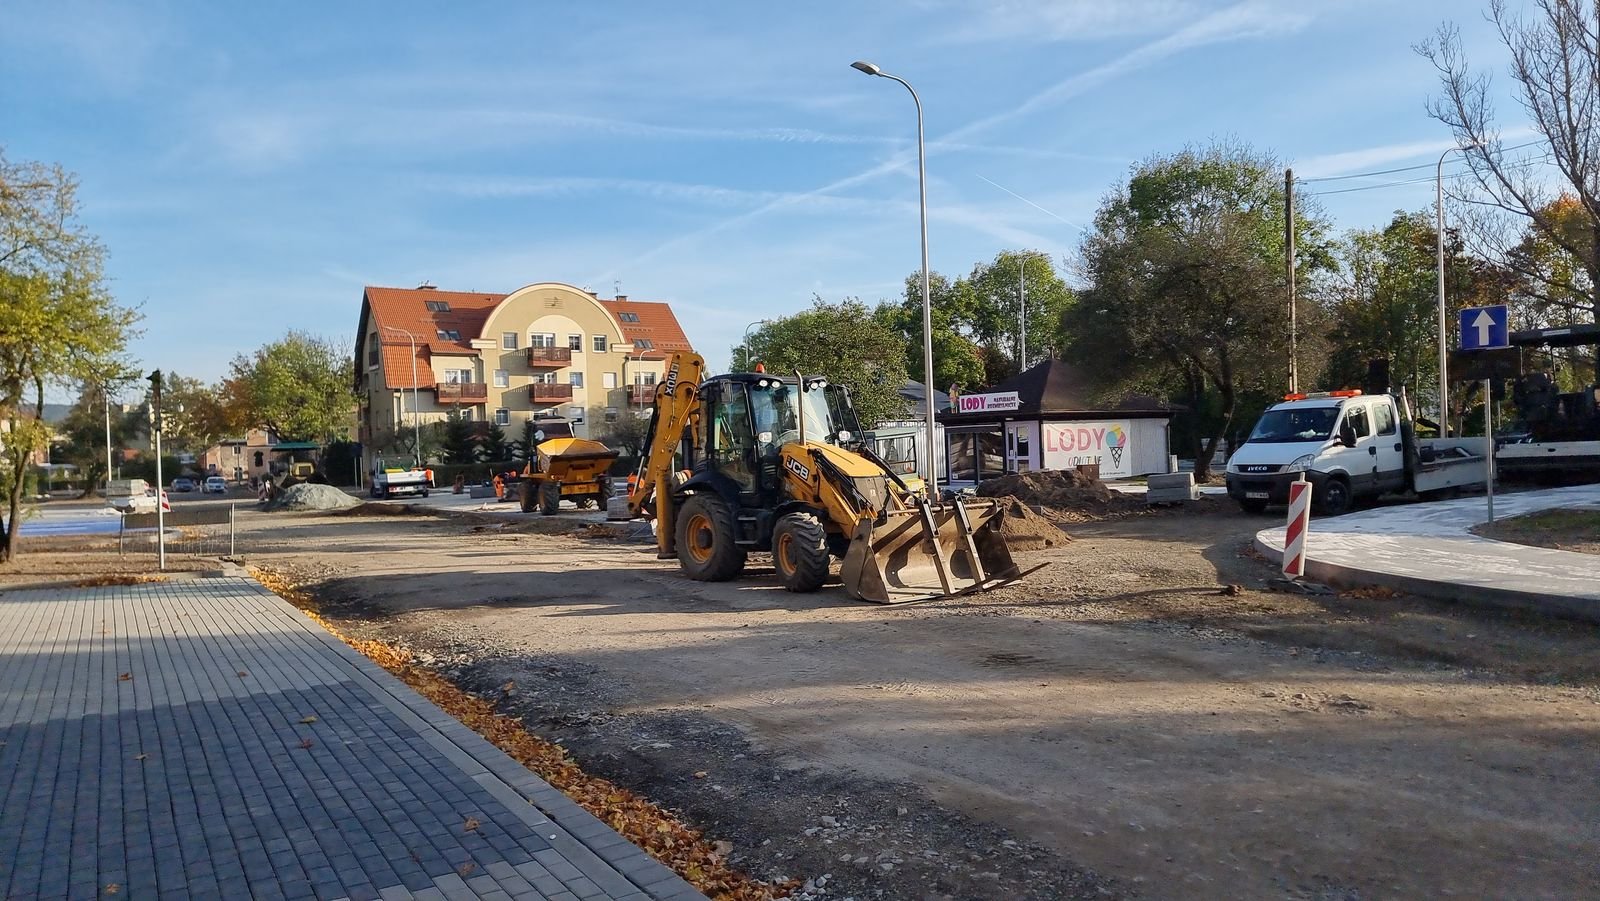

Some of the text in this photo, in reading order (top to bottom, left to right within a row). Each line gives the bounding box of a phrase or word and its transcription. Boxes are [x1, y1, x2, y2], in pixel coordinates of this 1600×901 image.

[961, 396, 987, 411] LODY
[1046, 428, 1106, 452] LODY
[786, 458, 809, 480] JCB
